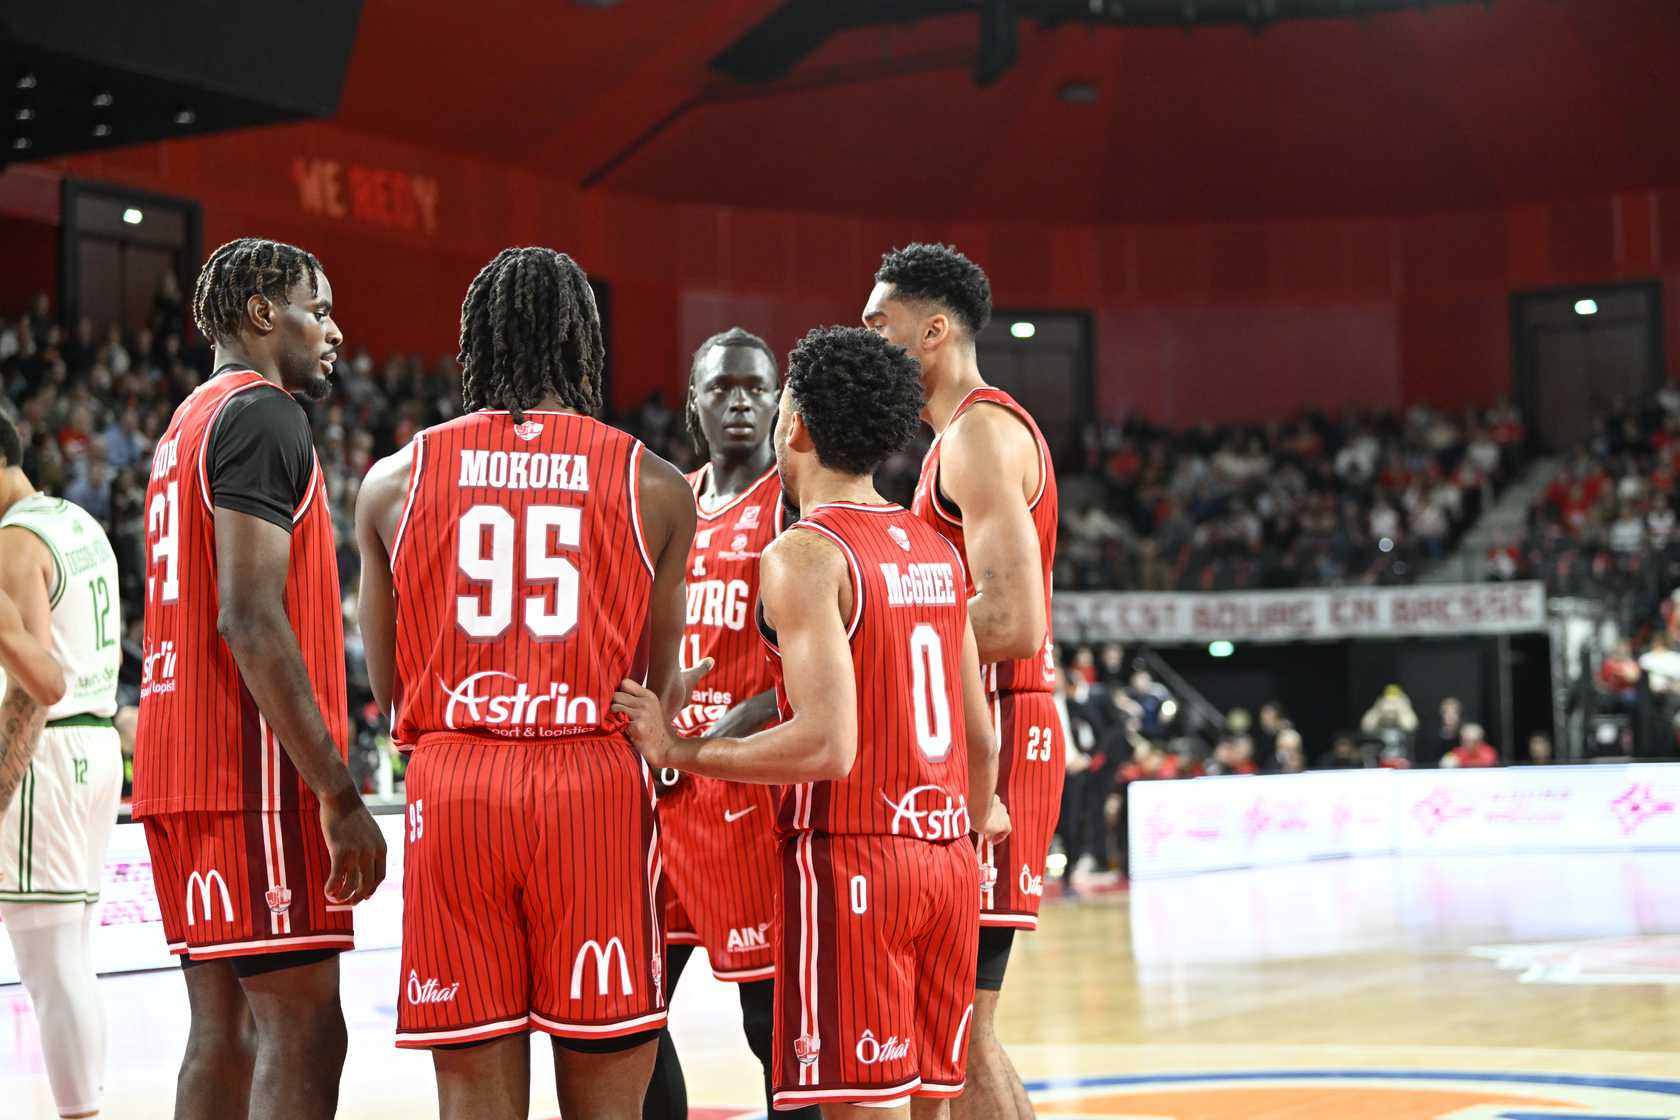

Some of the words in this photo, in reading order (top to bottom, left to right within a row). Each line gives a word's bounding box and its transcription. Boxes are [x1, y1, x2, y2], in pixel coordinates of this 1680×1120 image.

[458, 449, 589, 491] MOKOKA
[456, 505, 582, 637] 95
[88, 575, 116, 652] 12
[686, 579, 749, 631] URG
[435, 670, 597, 730] Astr'in
[692, 687, 732, 705] arles
[910, 623, 952, 758] 0
[1026, 726, 1052, 761] 23
[72, 757, 88, 785] 12
[409, 799, 424, 843] 95
[851, 875, 868, 915] 0
[727, 927, 765, 948] AIN
[407, 969, 460, 1005] Ôthaï
[856, 1029, 910, 1064] Ôthaï
